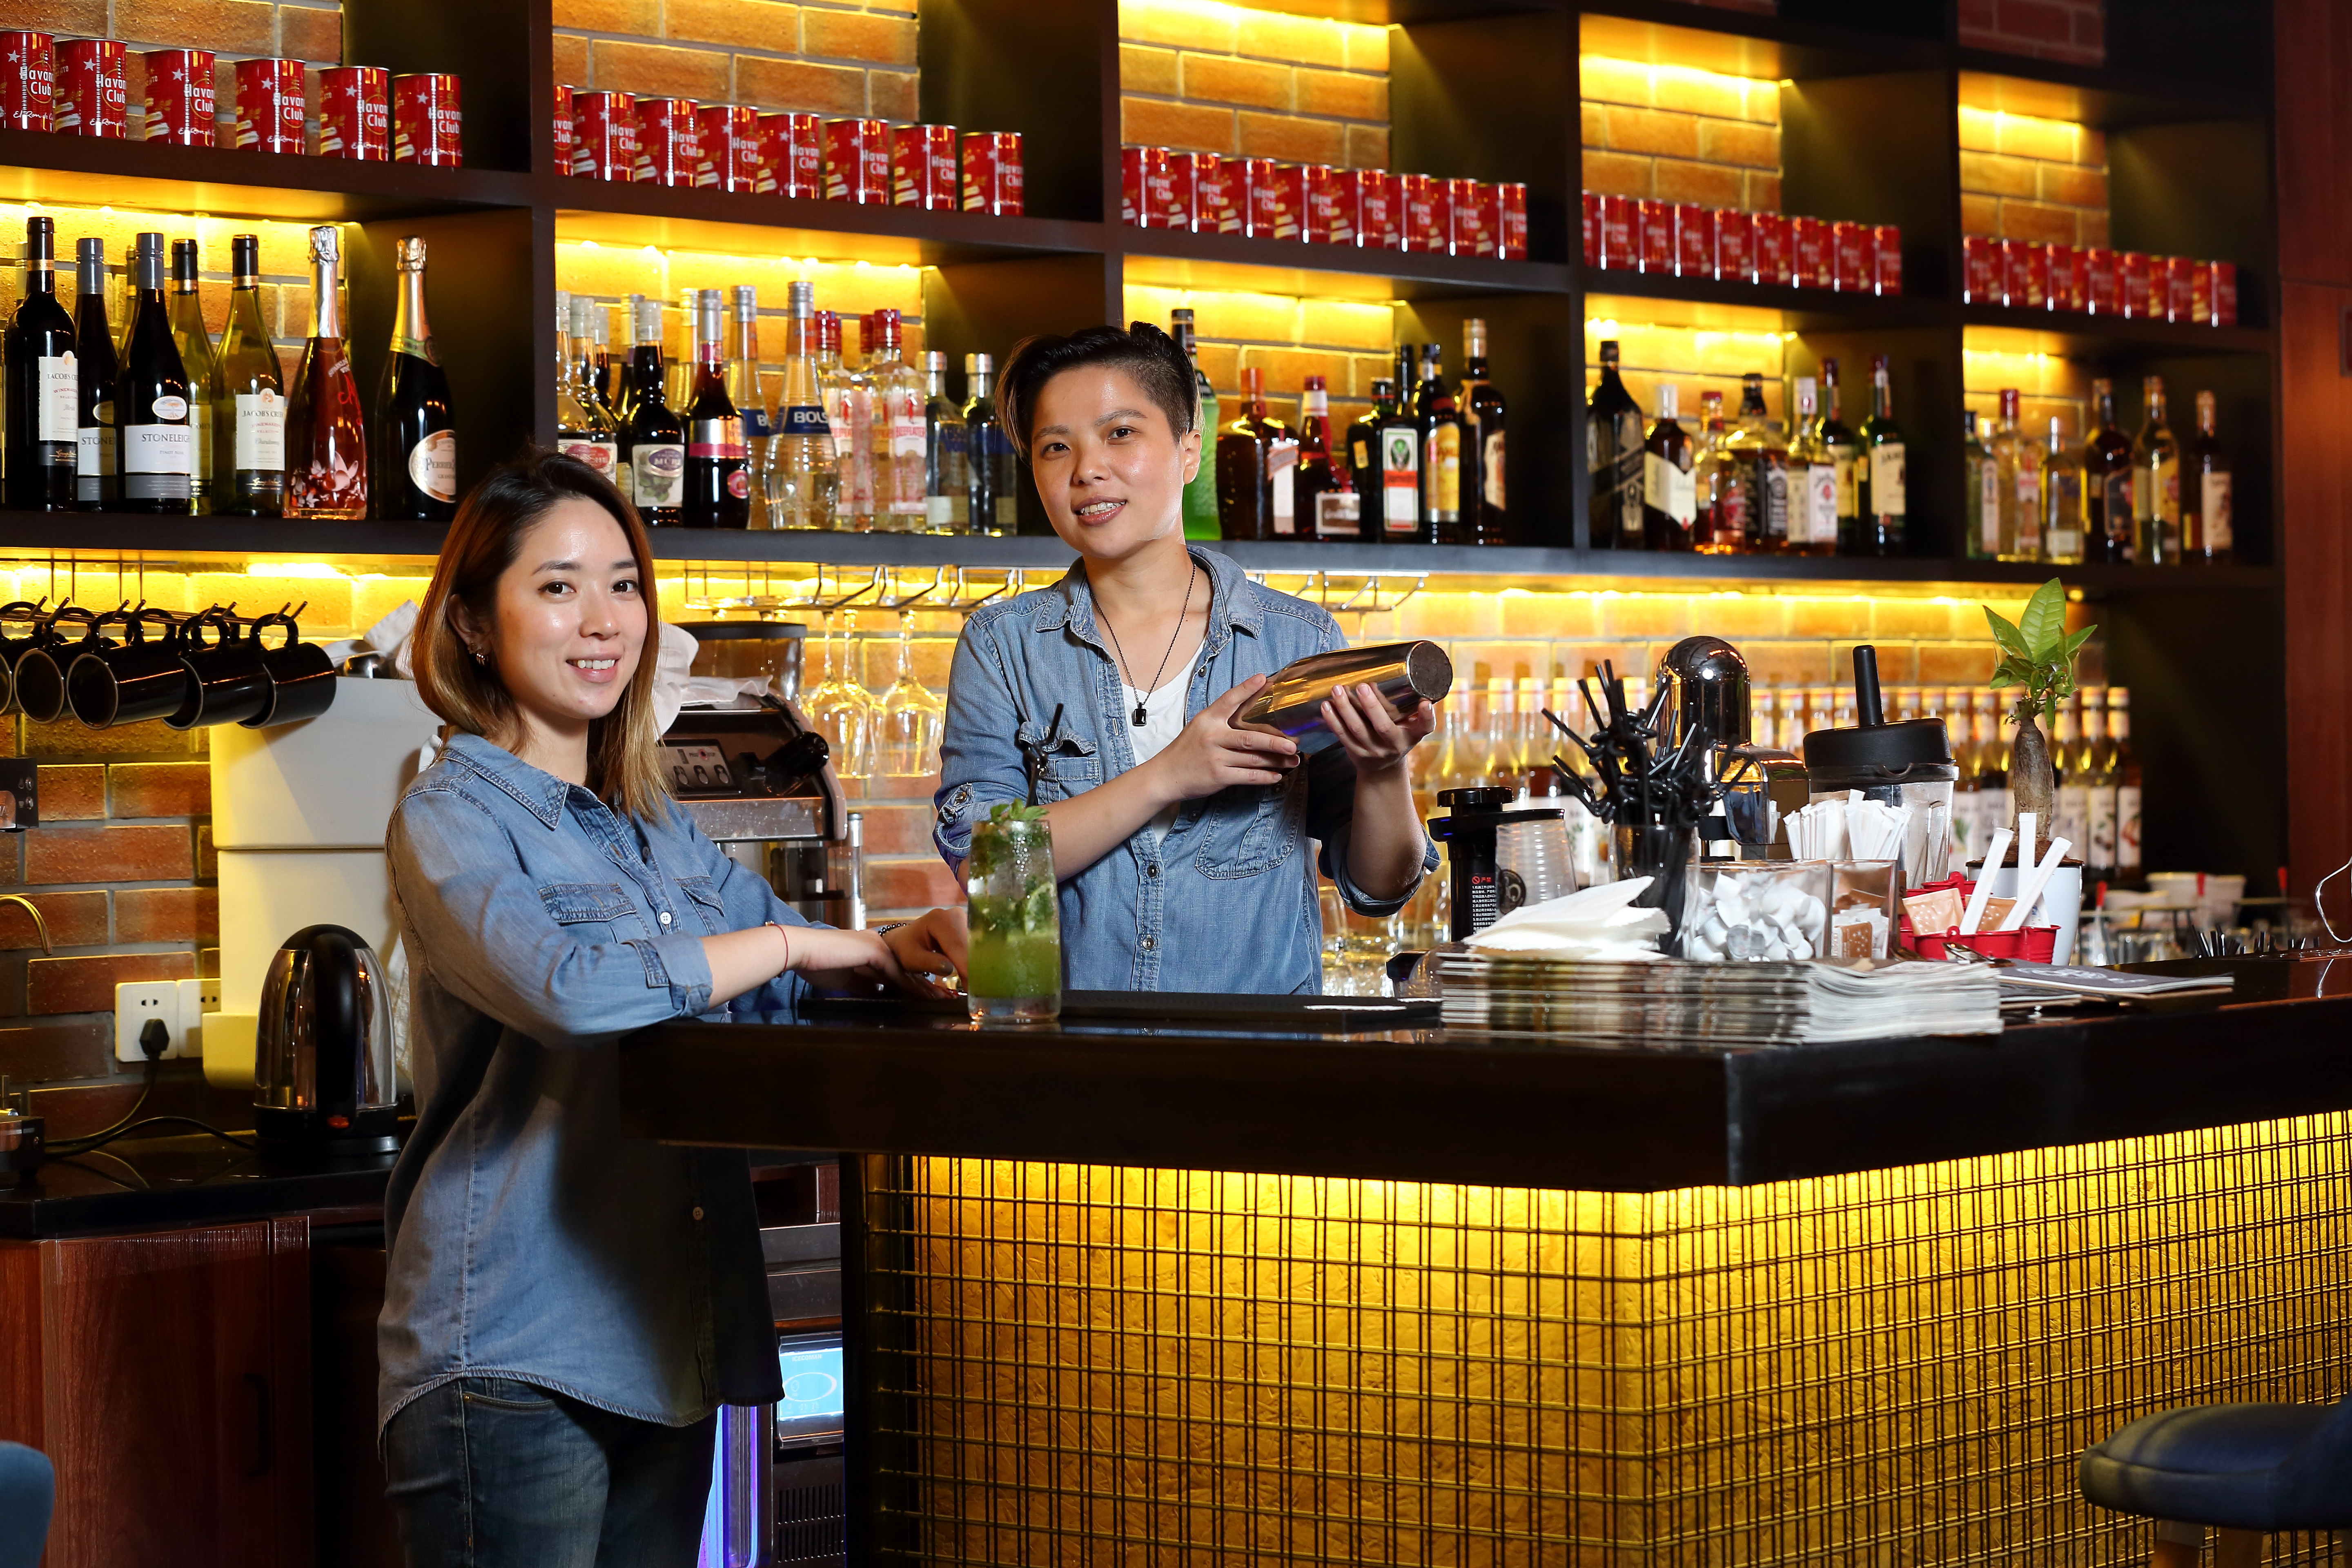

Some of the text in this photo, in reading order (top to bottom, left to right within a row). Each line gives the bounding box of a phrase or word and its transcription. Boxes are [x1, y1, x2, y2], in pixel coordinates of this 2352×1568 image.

[20, 66, 53, 82] Havan
[31, 81, 51, 96] Club
[106, 89, 125, 104] Club
[274, 92, 305, 108] Havan
[194, 99, 214, 113] Club
[357, 100, 388, 114] Havan
[283, 107, 304, 120] Club
[428, 107, 462, 121] Havan
[368, 114, 387, 128] Club
[438, 121, 460, 134] Club
[82, 437, 113, 445] STONE
